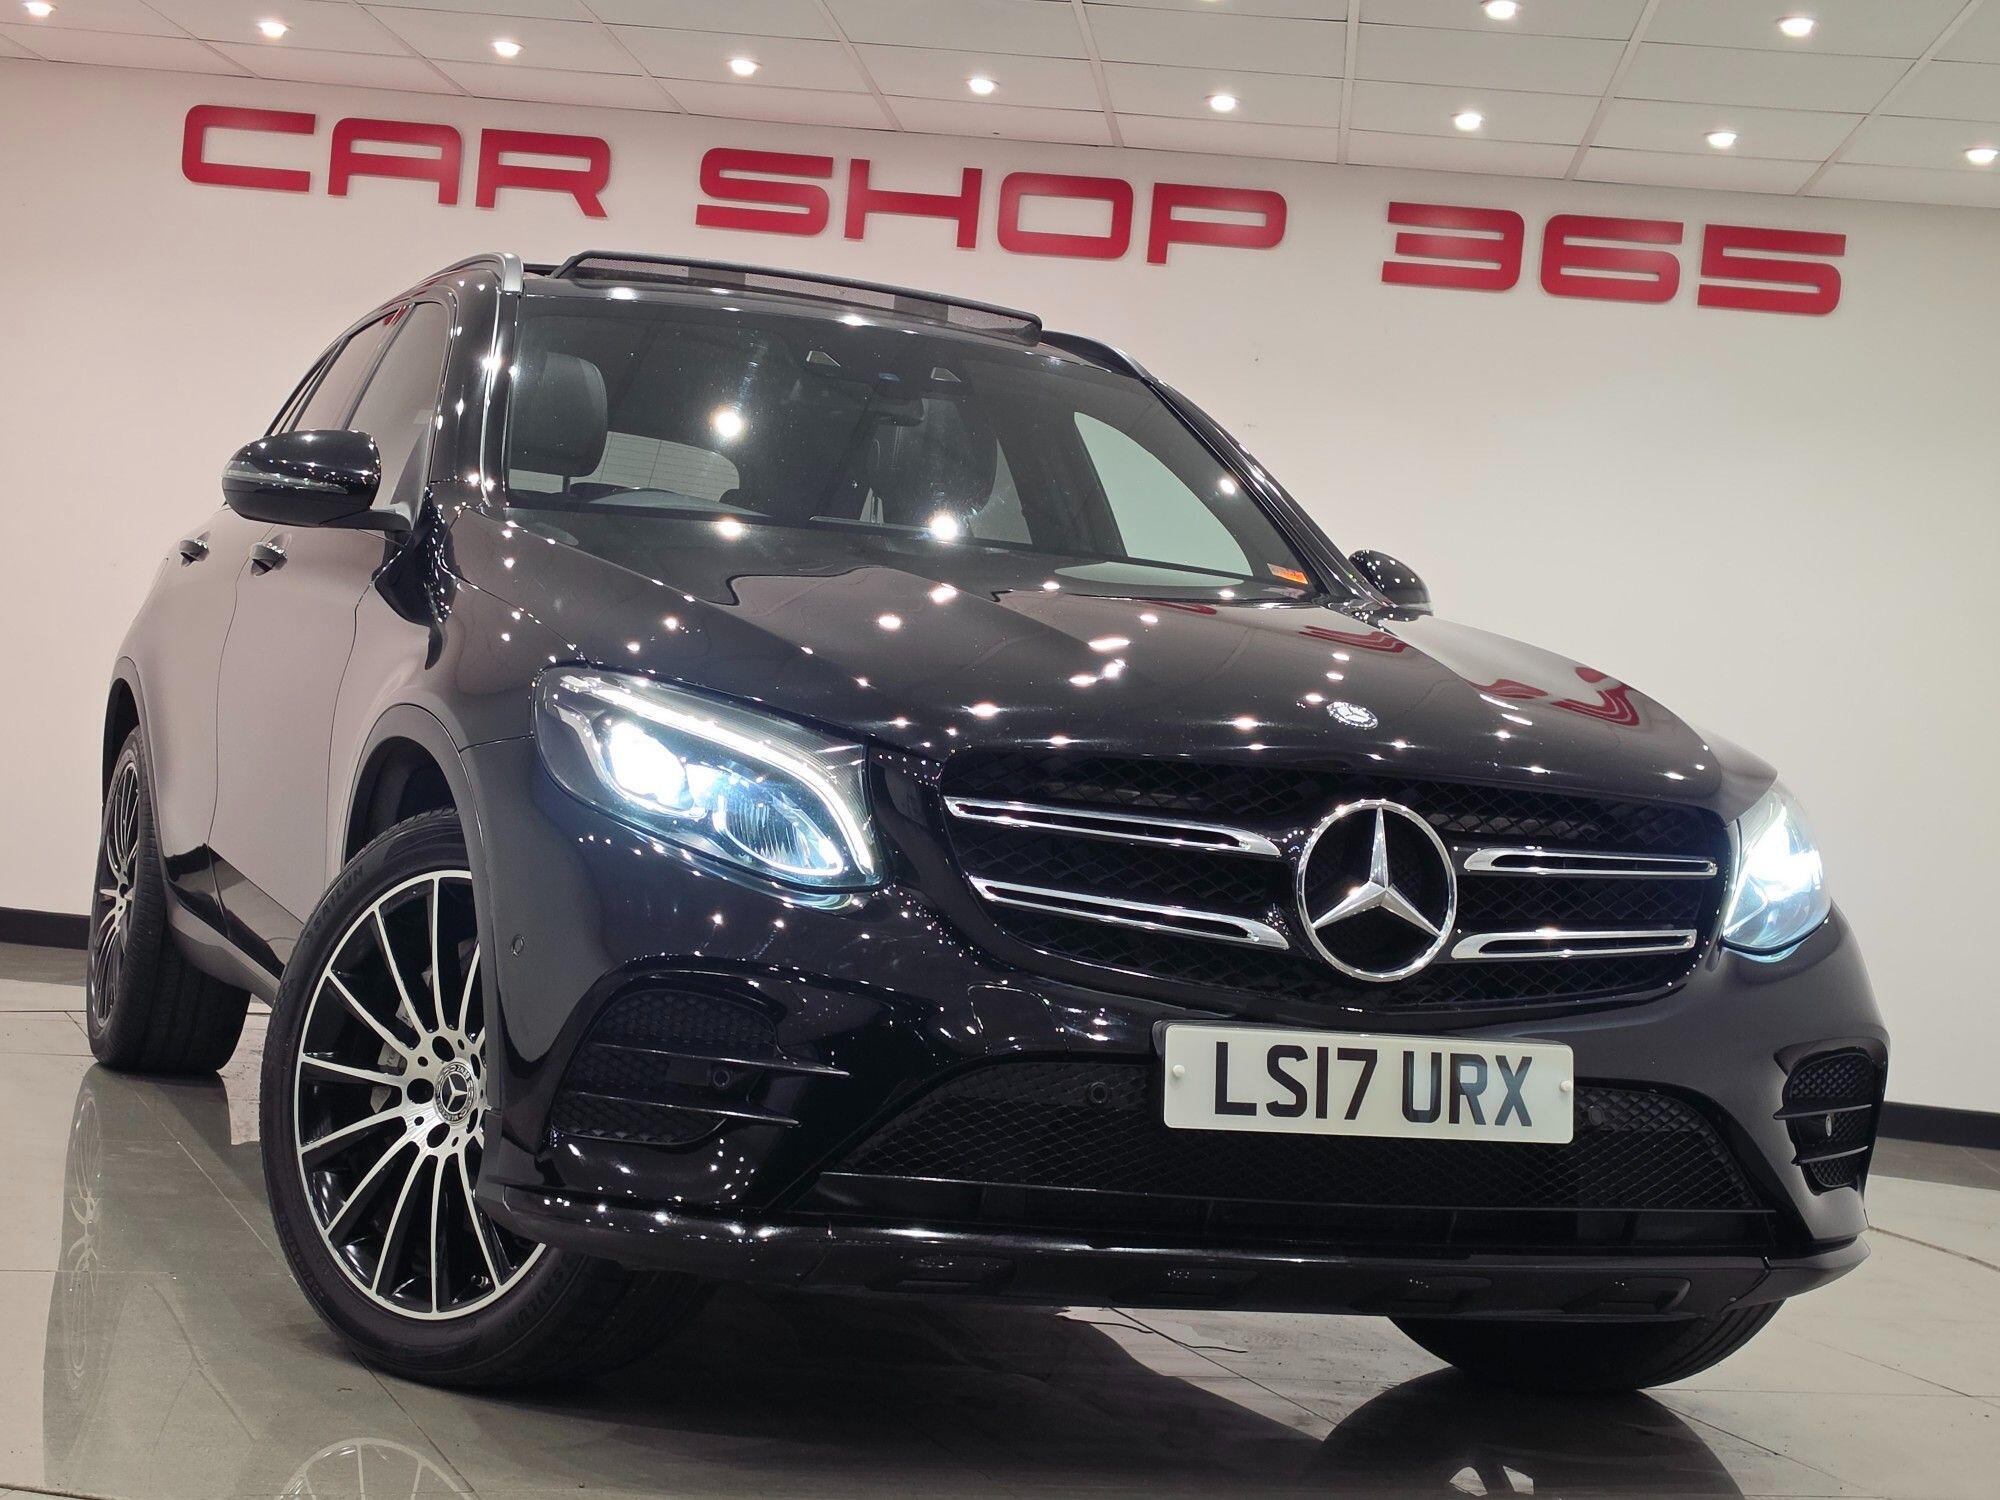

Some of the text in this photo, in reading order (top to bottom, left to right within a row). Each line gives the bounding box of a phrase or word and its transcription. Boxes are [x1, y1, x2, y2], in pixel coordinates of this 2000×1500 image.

[182, 105, 1845, 314] CAR SHOP 365
[1214, 1041, 1532, 1127] LS17 URX
